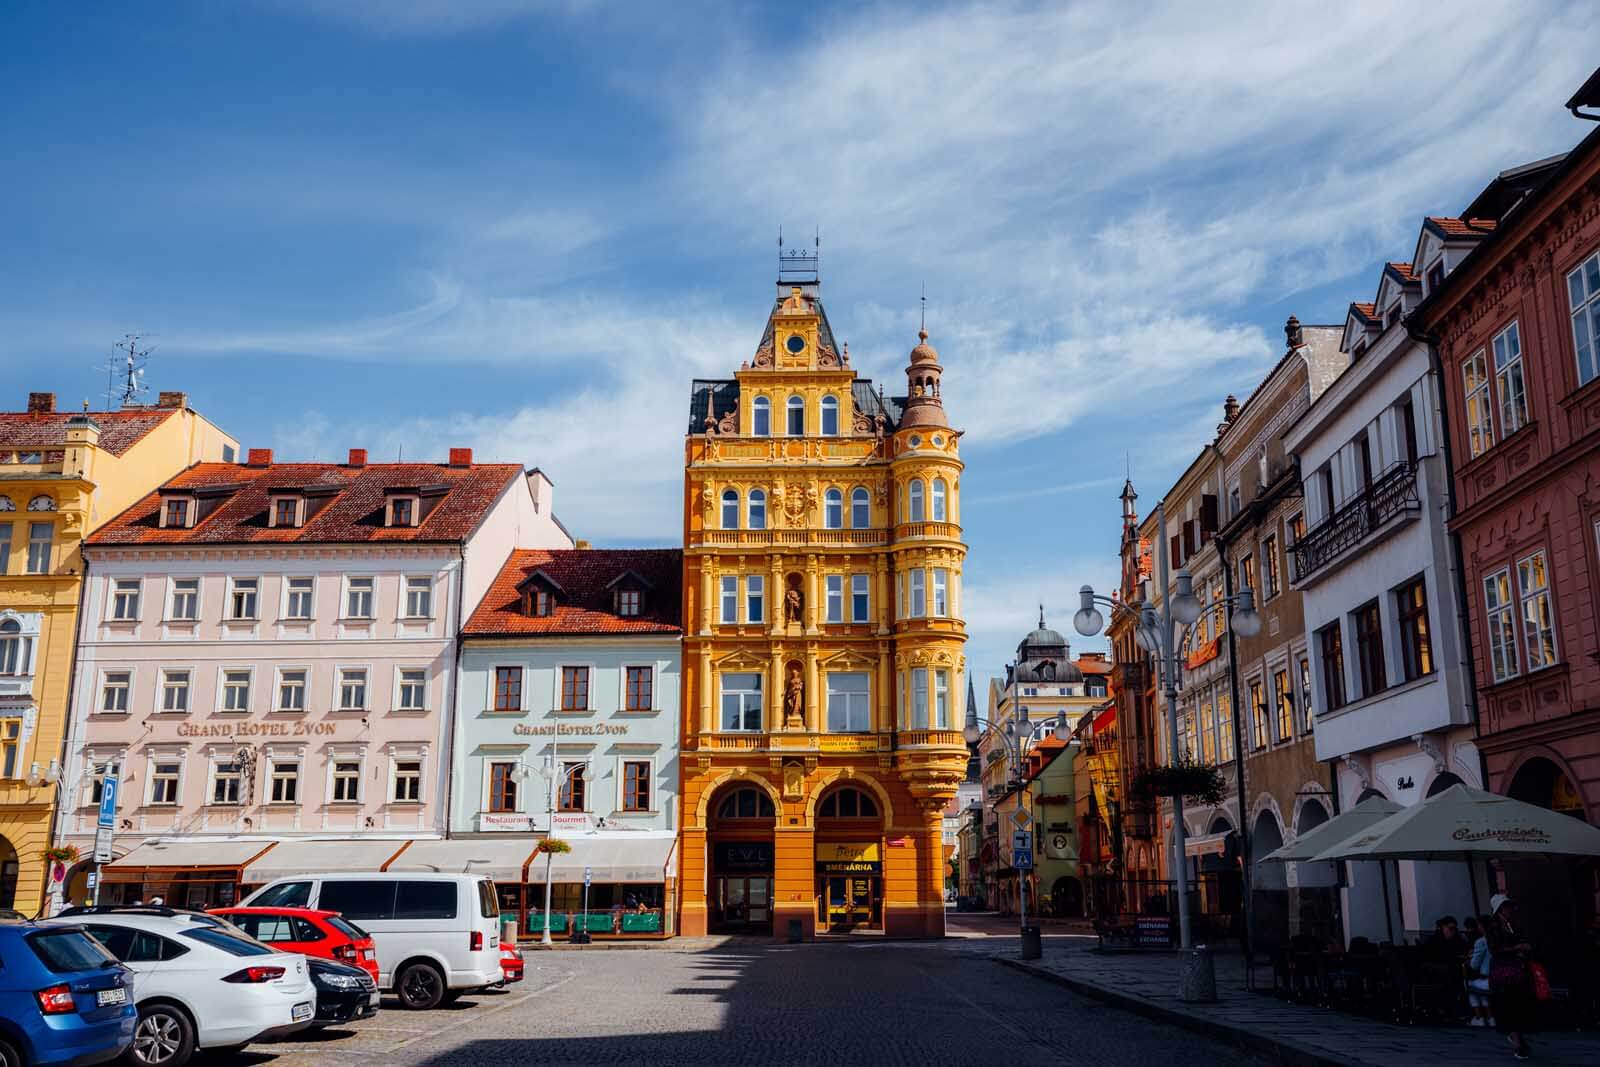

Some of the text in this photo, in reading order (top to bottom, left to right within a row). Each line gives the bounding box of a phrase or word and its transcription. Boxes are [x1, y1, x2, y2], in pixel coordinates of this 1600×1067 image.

[177, 721, 336, 736] GRAND HOTEL ZVON
[103, 783, 113, 810] P
[485, 816, 530, 824] Restaurant
